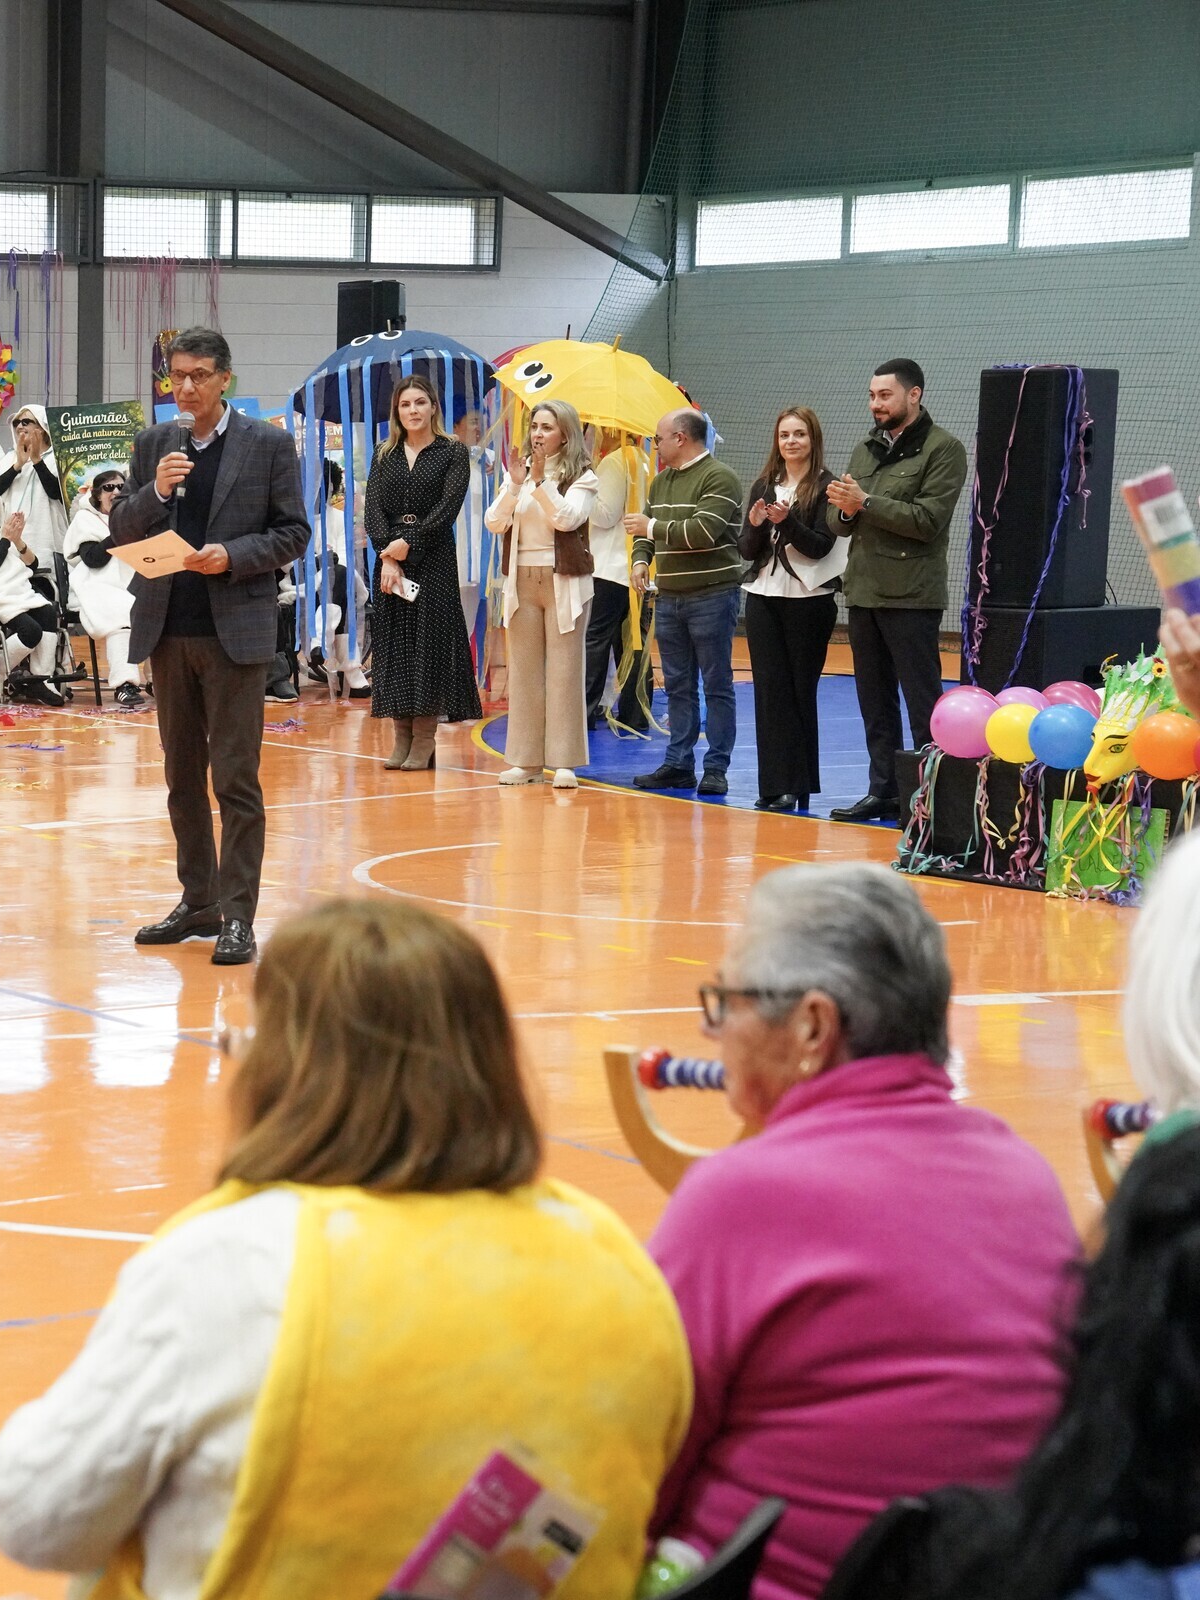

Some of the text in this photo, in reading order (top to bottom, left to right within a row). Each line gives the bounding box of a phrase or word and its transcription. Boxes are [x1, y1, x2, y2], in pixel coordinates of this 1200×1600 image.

[60, 411, 131, 431] Guimarães
[61, 431, 81, 442] cuida
[82, 429, 92, 439] da
[75, 444, 88, 453] nós
[89, 442, 112, 451] somos
[87, 451, 108, 463] parte
